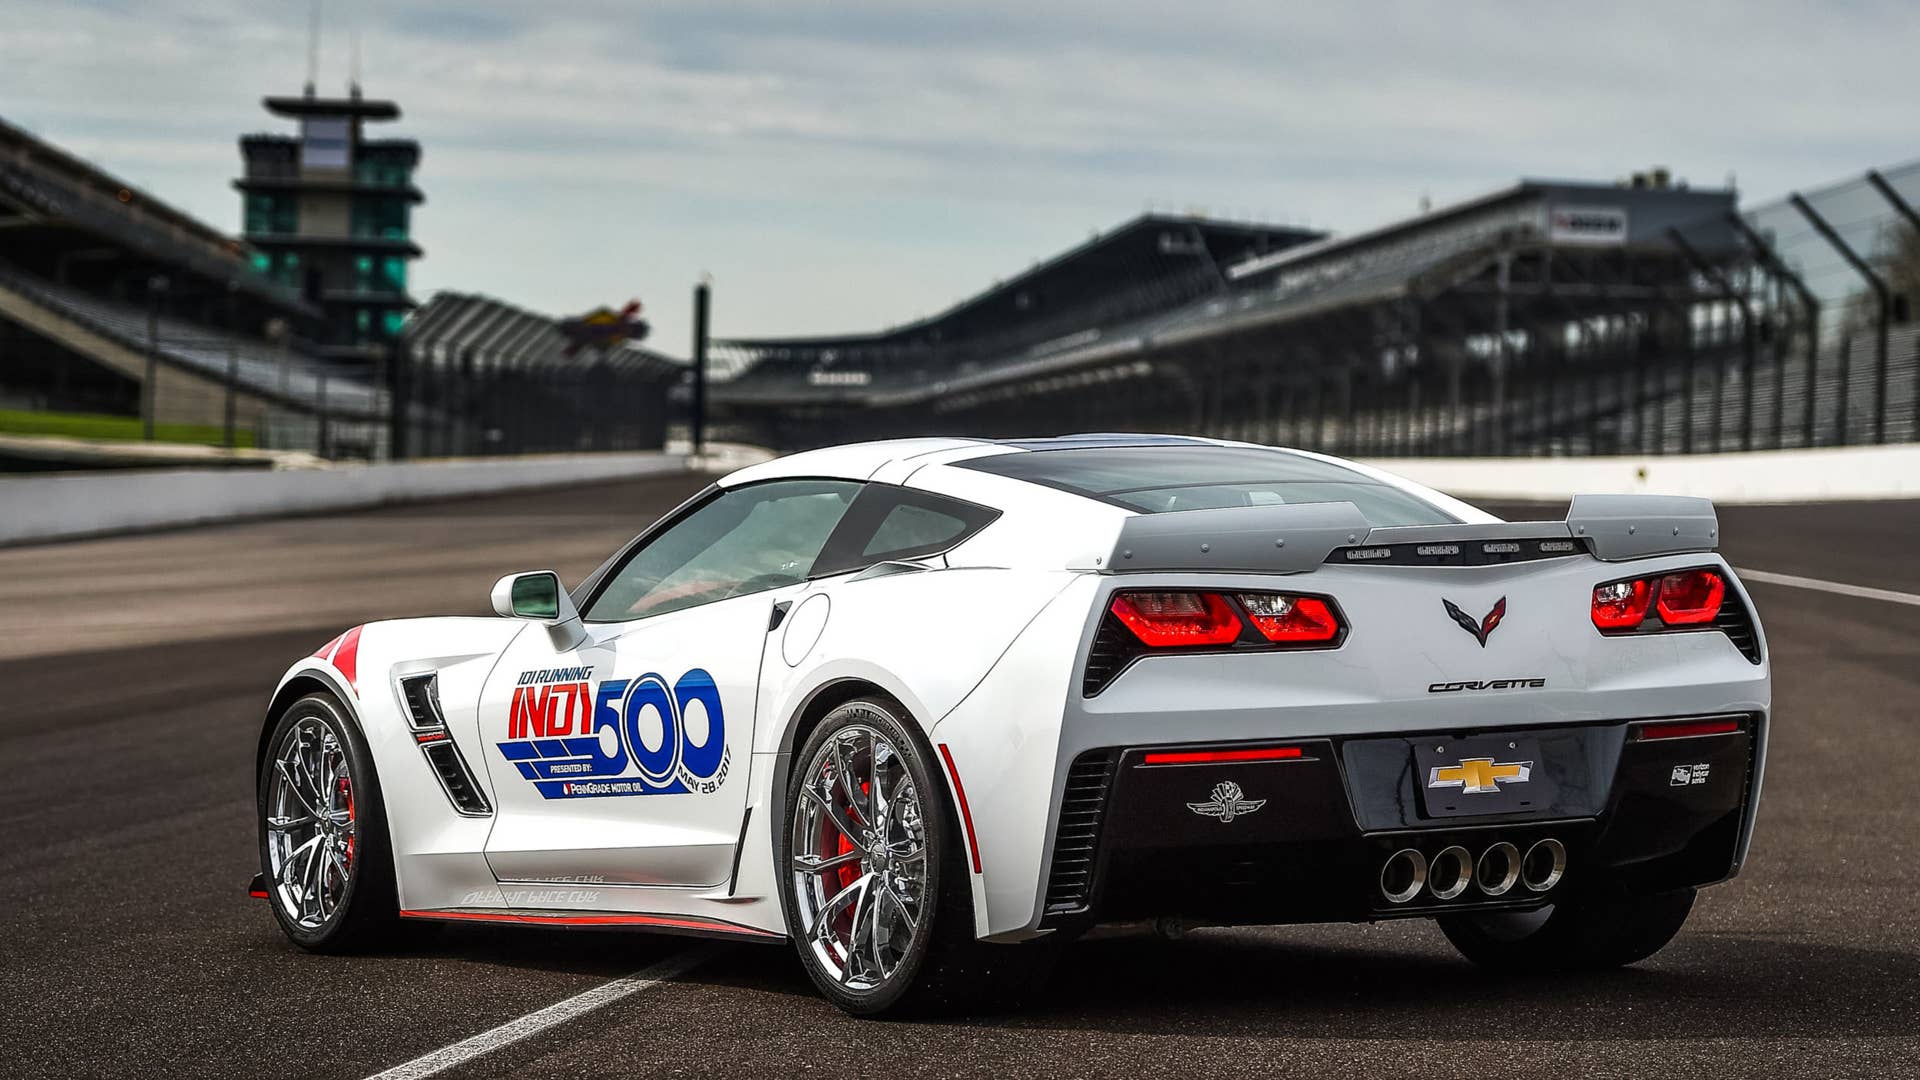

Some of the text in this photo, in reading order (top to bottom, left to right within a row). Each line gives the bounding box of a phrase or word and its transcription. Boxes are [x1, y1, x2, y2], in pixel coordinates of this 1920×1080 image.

[517, 665, 594, 686] 101 RUNNING
[1428, 678, 1546, 693] CORVETTE
[508, 668, 725, 784] INDY 500
[550, 763, 593, 774] PRESENTED BY:
[678, 764, 700, 792] MAY
[611, 782, 633, 794] MOTOR
[632, 782, 644, 792] OIL
